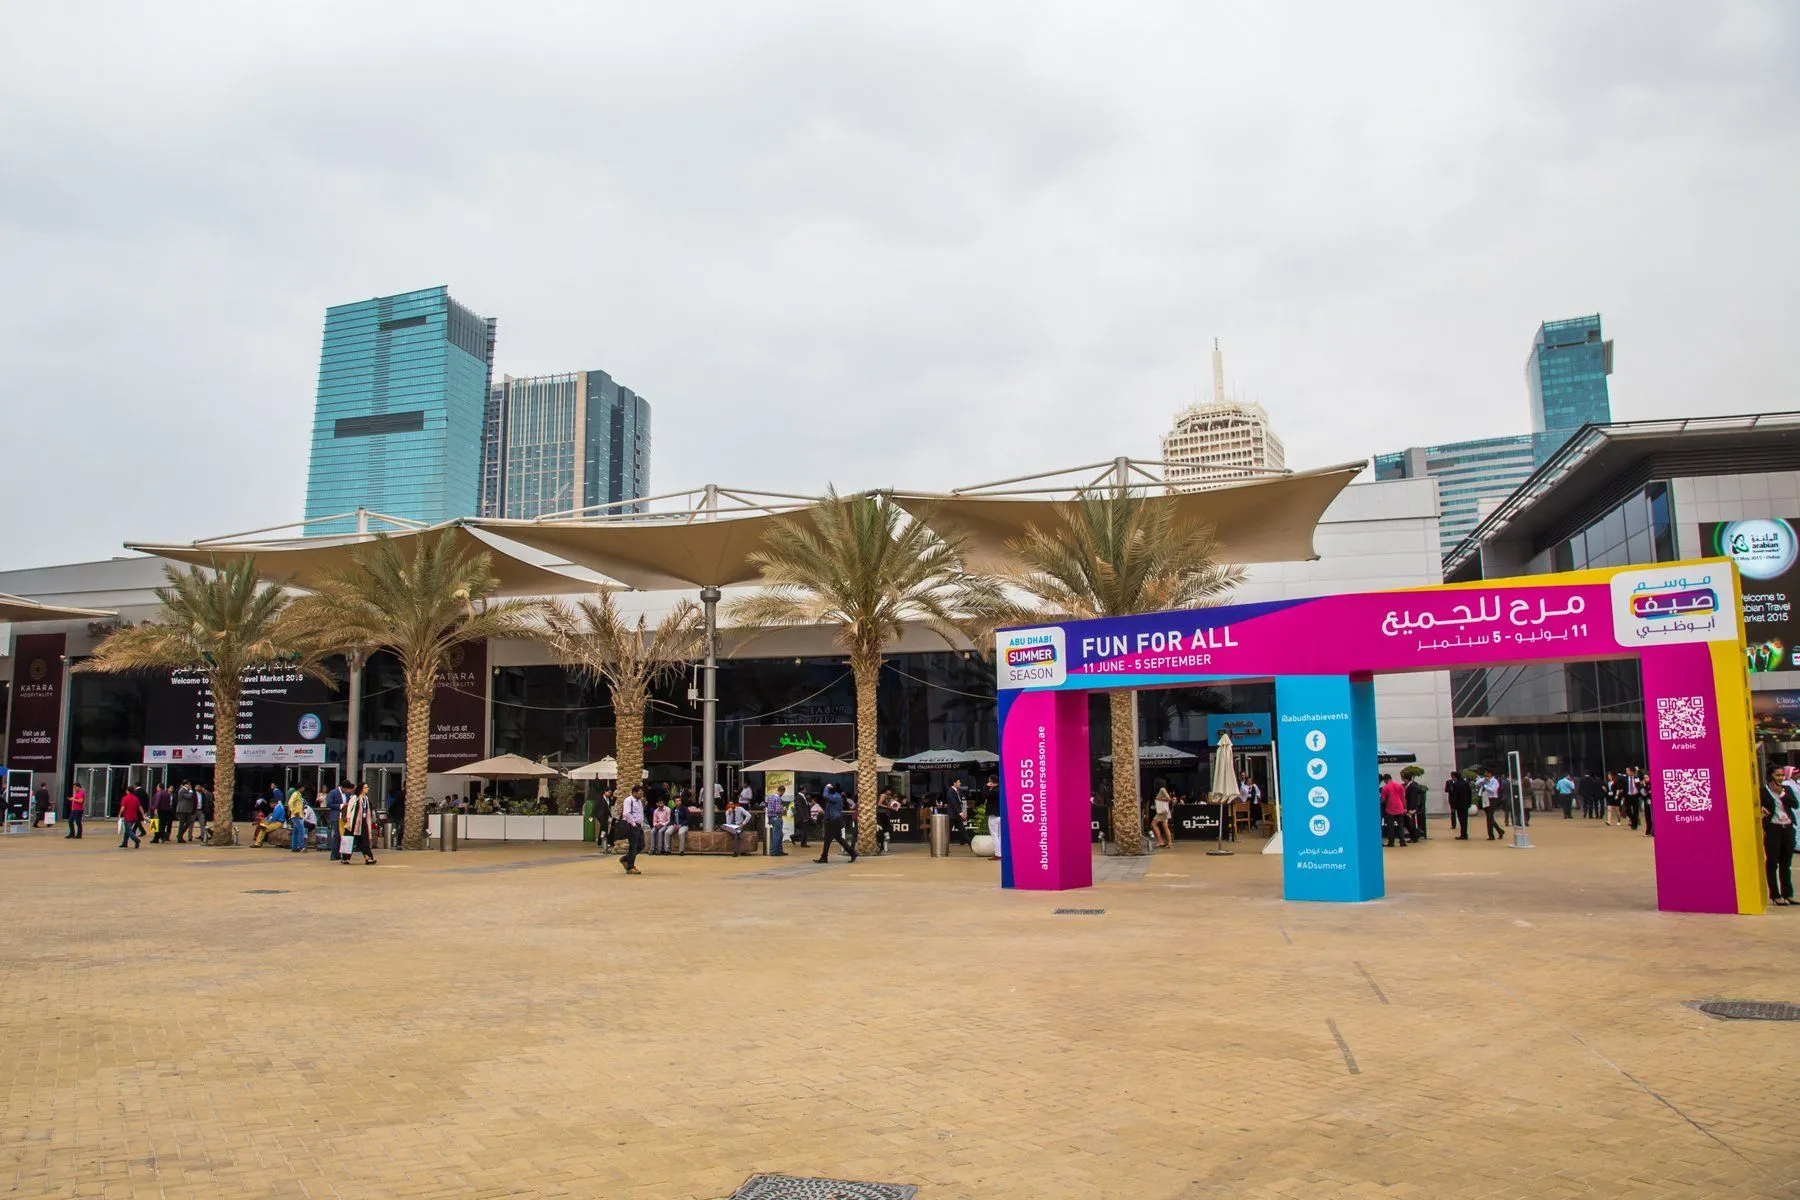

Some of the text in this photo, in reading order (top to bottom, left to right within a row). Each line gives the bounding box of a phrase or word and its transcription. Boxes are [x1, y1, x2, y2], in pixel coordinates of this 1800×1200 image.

[1633, 576, 1711, 593] موسم
[1777, 593, 1785, 601] to
[1634, 595, 1714, 614] صيف
[1742, 603, 1790, 612] abian Travel
[1381, 594, 1585, 636] مرح للجميع
[1744, 613, 1788, 622] arket 2015
[1572, 624, 1588, 637] 11
[1636, 616, 1715, 639] أبوظبي
[1009, 635, 1052, 646] ABU DHABI
[1492, 631, 1501, 643] 5
[1515, 628, 1568, 643] يونيو
[1083, 626, 1238, 658] FUN FOR ALL
[1417, 634, 1489, 651] سبتمبر
[1009, 648, 1052, 662] SUMMER
[1083, 663, 1094, 673] 11
[1097, 661, 1125, 672] JUNE
[1135, 660, 1142, 669] 5
[1144, 654, 1211, 669] SEPTEMBER
[239, 674, 259, 683] avel
[260, 674, 285, 682] Market
[1010, 668, 1053, 680] SEASON
[171, 677, 200, 685] Welcome
[202, 676, 209, 684] to
[1281, 713, 1349, 722] @abudhabievents
[1021, 758, 1035, 823] 800 555
[1038, 726, 1048, 870] abudhabisummerseason.ae
[1675, 815, 1704, 823] English
[876, 823, 909, 832] NRO
[1297, 861, 1347, 870] #ADsummer
